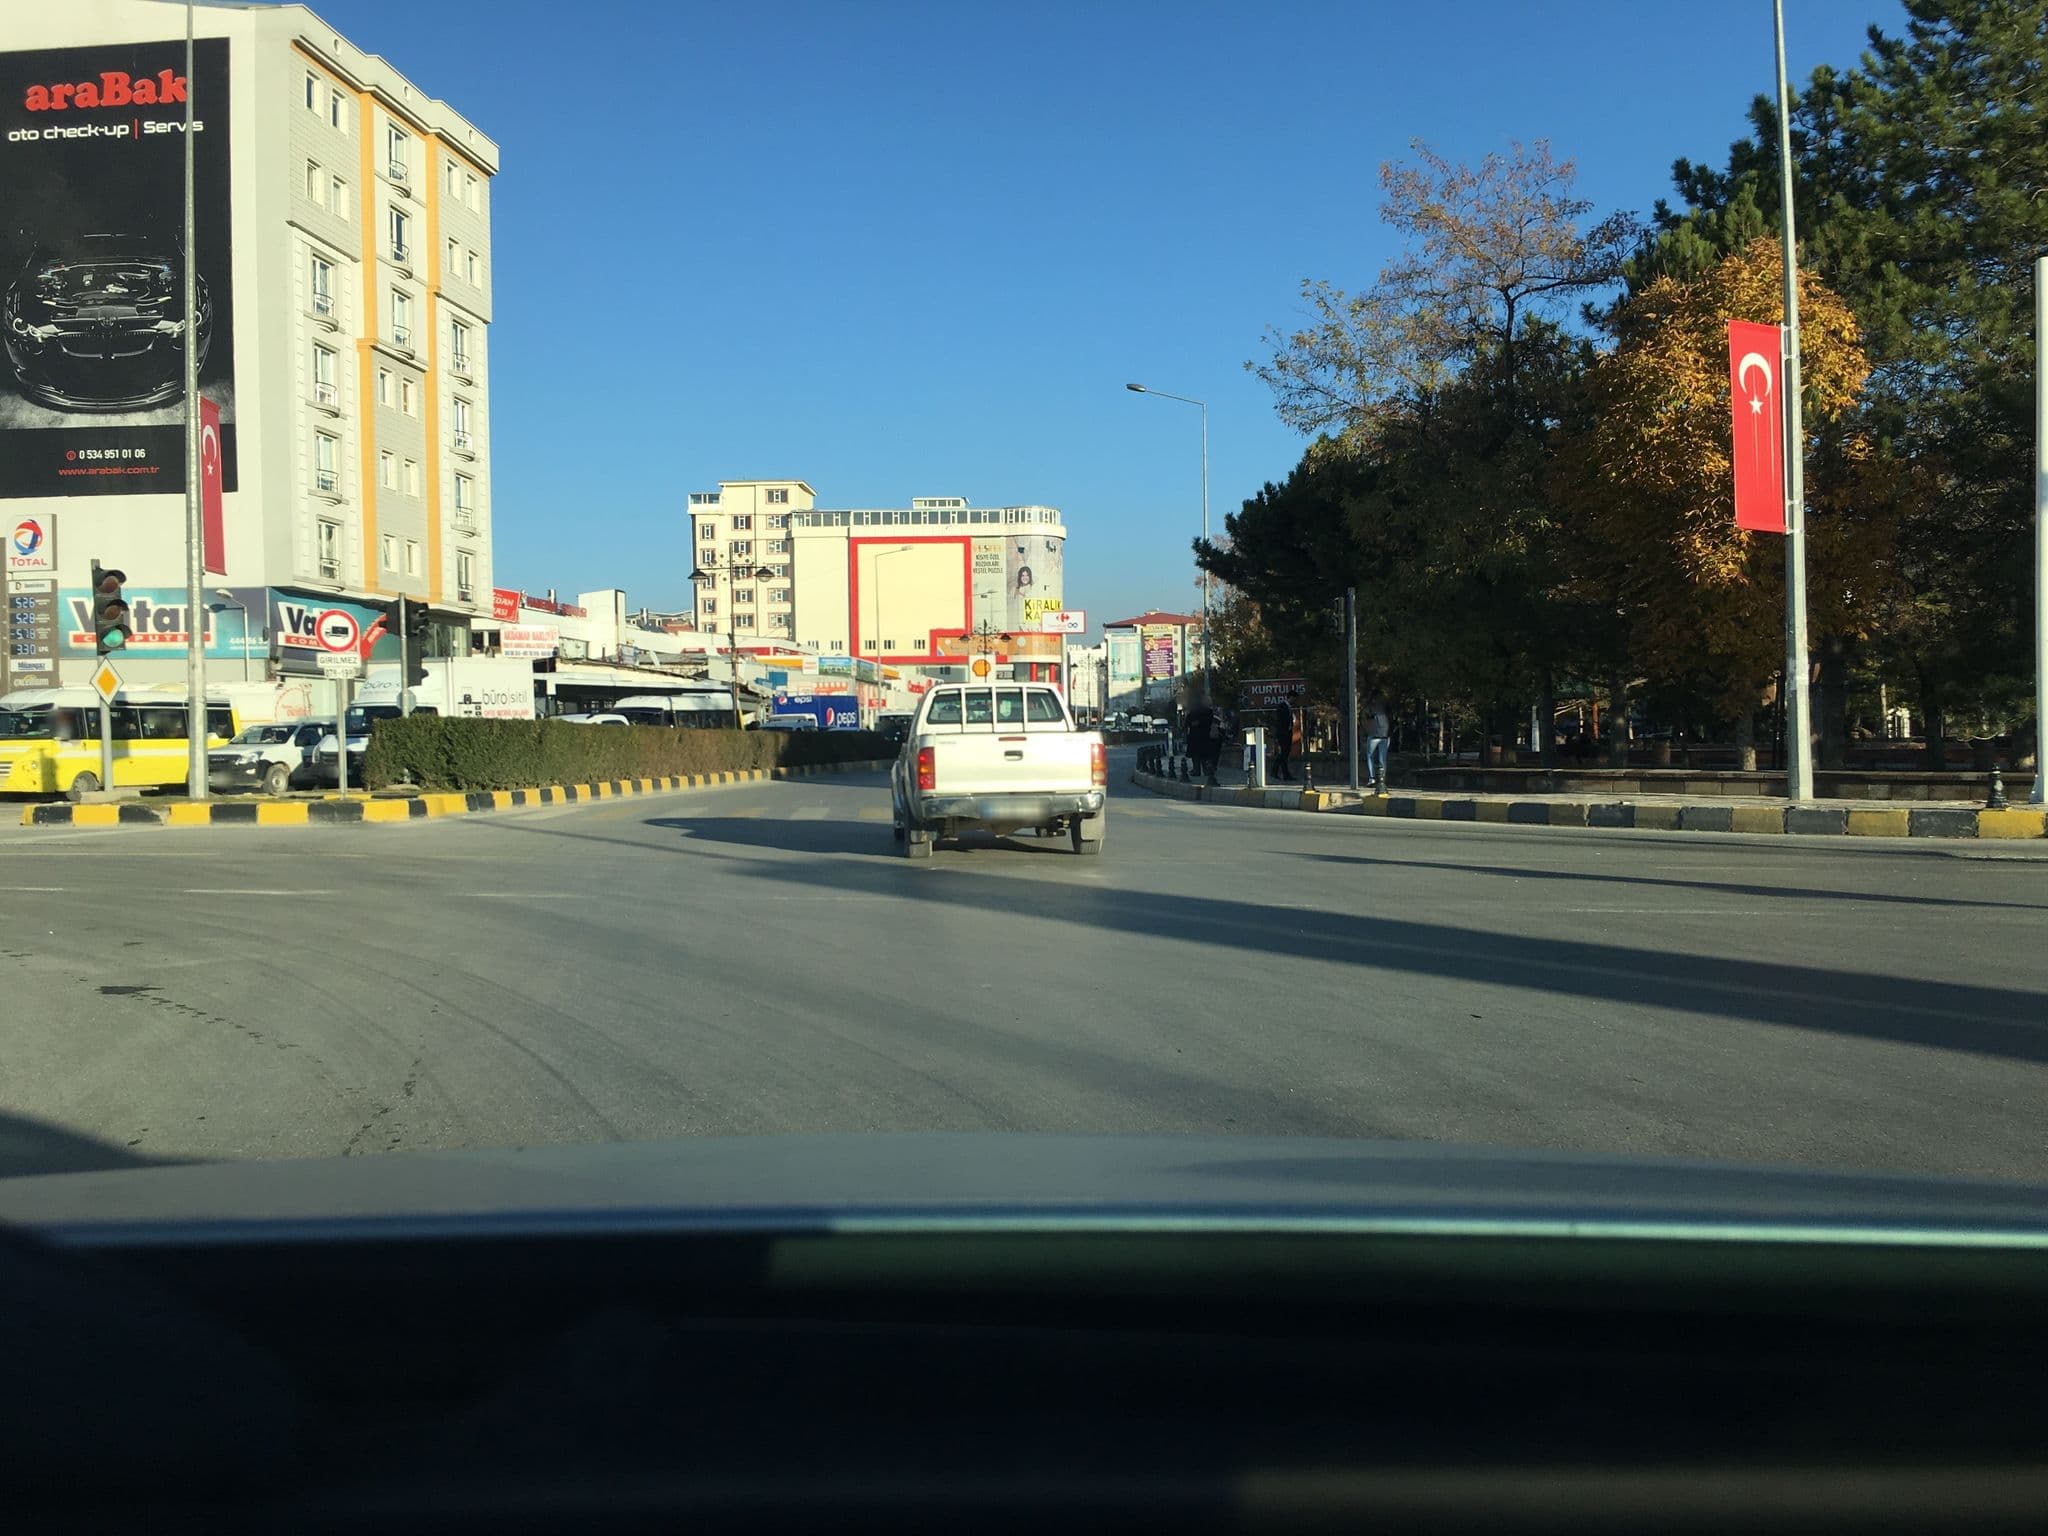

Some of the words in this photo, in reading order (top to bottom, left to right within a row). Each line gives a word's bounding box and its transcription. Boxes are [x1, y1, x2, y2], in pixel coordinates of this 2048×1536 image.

[25, 68, 187, 112] araBak
[8, 128, 39, 142] oto
[43, 124, 130, 141] check-up
[143, 120, 204, 134] Servs
[79, 450, 85, 460] 0
[86, 450, 103, 460] 534
[104, 449, 119, 459] 951
[121, 449, 132, 458] 01
[134, 448, 146, 458] 06
[58, 466, 160, 476] www.arabak.com.tr
[10, 557, 48, 567] TOTAL
[70, 599, 210, 634] Vta
[482, 687, 508, 705] büro
